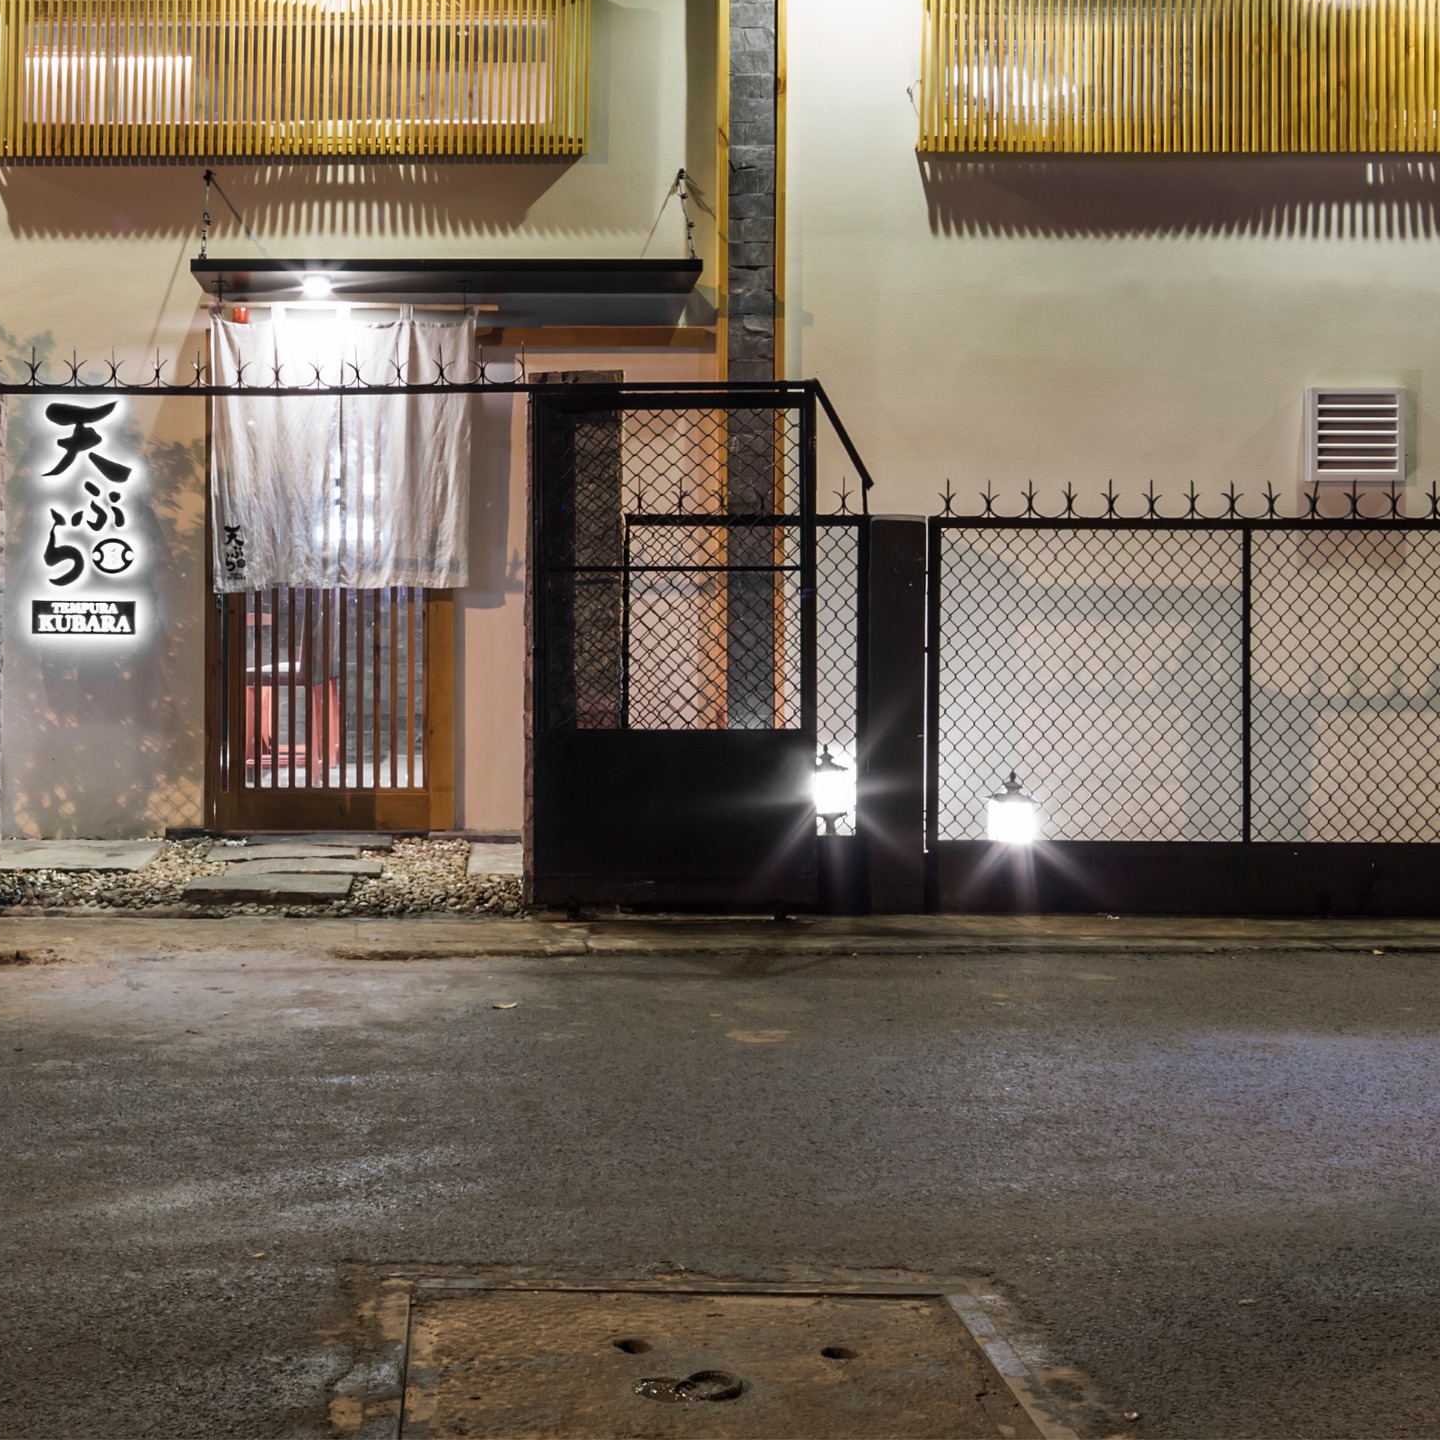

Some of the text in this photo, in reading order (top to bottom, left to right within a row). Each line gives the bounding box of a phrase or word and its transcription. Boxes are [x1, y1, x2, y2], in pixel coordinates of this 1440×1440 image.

[41, 400, 132, 586] 天ぷら
[51, 602, 118, 614] TEMPURA
[38, 614, 132, 632] KUBARA
